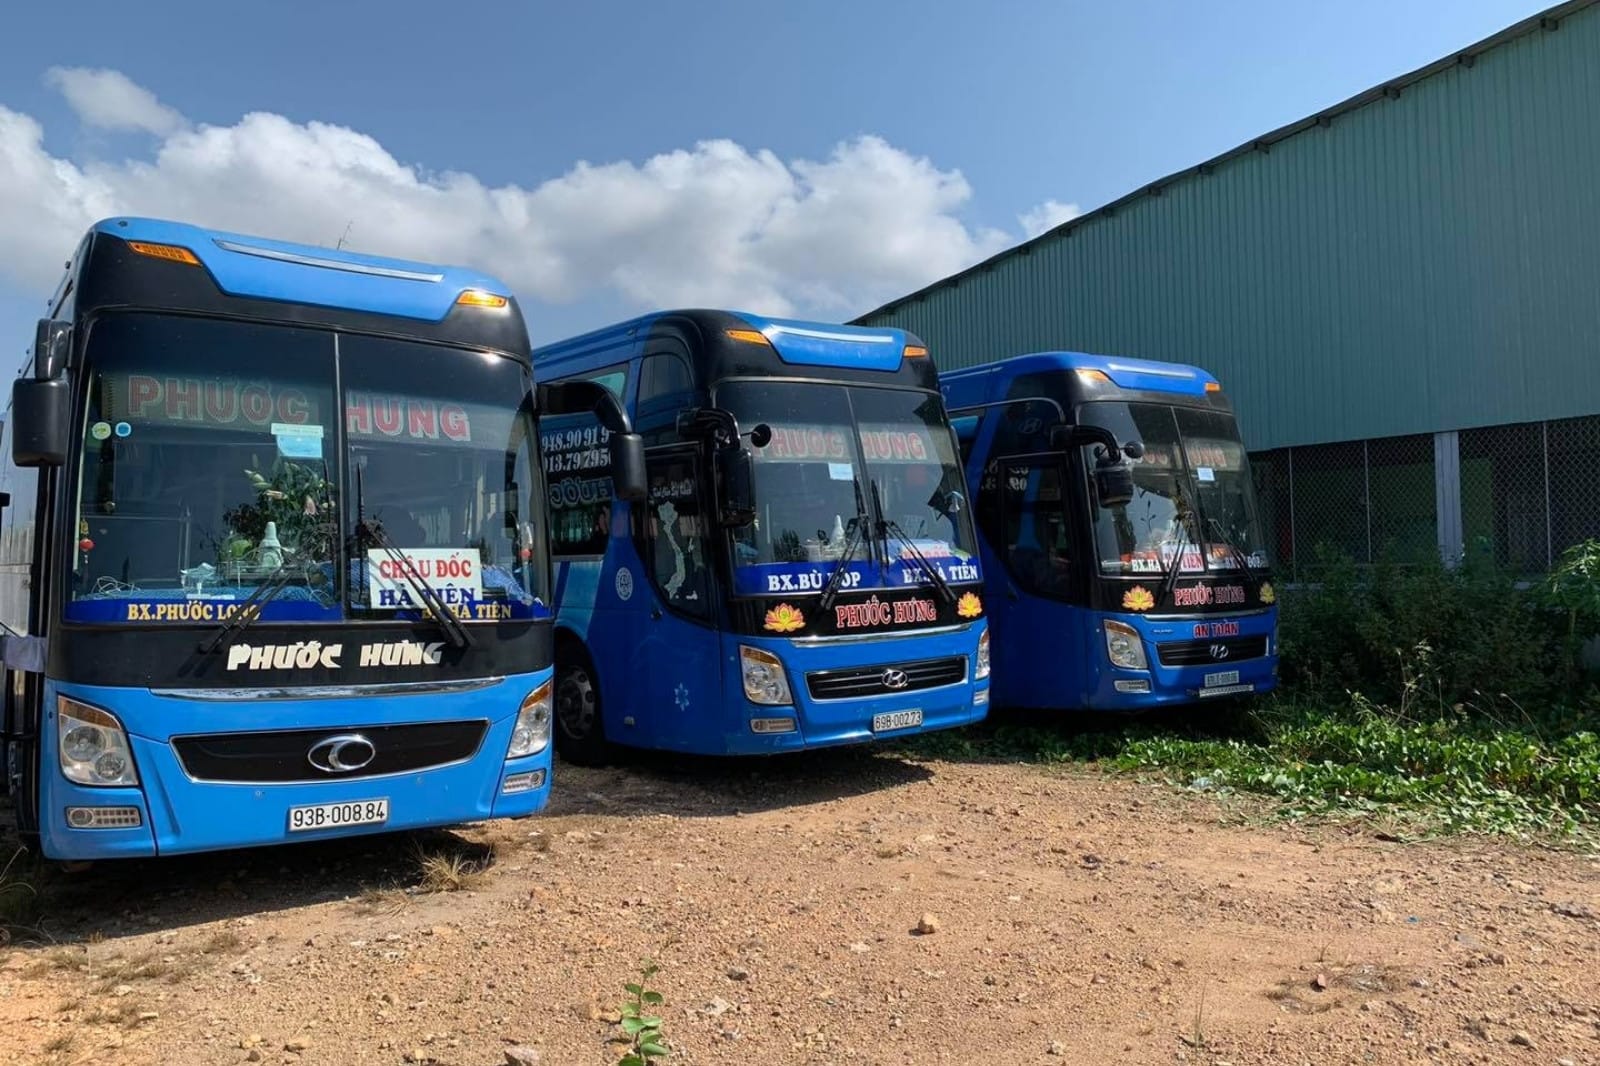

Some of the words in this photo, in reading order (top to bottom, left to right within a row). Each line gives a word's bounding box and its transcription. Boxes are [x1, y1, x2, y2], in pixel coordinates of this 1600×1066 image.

[436, 551, 472, 578] ĐỐC
[902, 562, 947, 584] BX.À
[949, 562, 979, 582] TIÊN
[768, 568, 823, 591] BX.BÙ
[379, 583, 415, 606] HÀ
[127, 600, 213, 620] BX.PHƯỚC
[475, 601, 512, 619] TIÊN
[835, 594, 892, 629] PHƯỚC
[893, 597, 937, 624] HƯNG
[1193, 622, 1209, 639] AN
[226, 640, 343, 671] PHƯỚC
[359, 639, 445, 667] HƯNG
[293, 801, 385, 828] 93B-008.84
